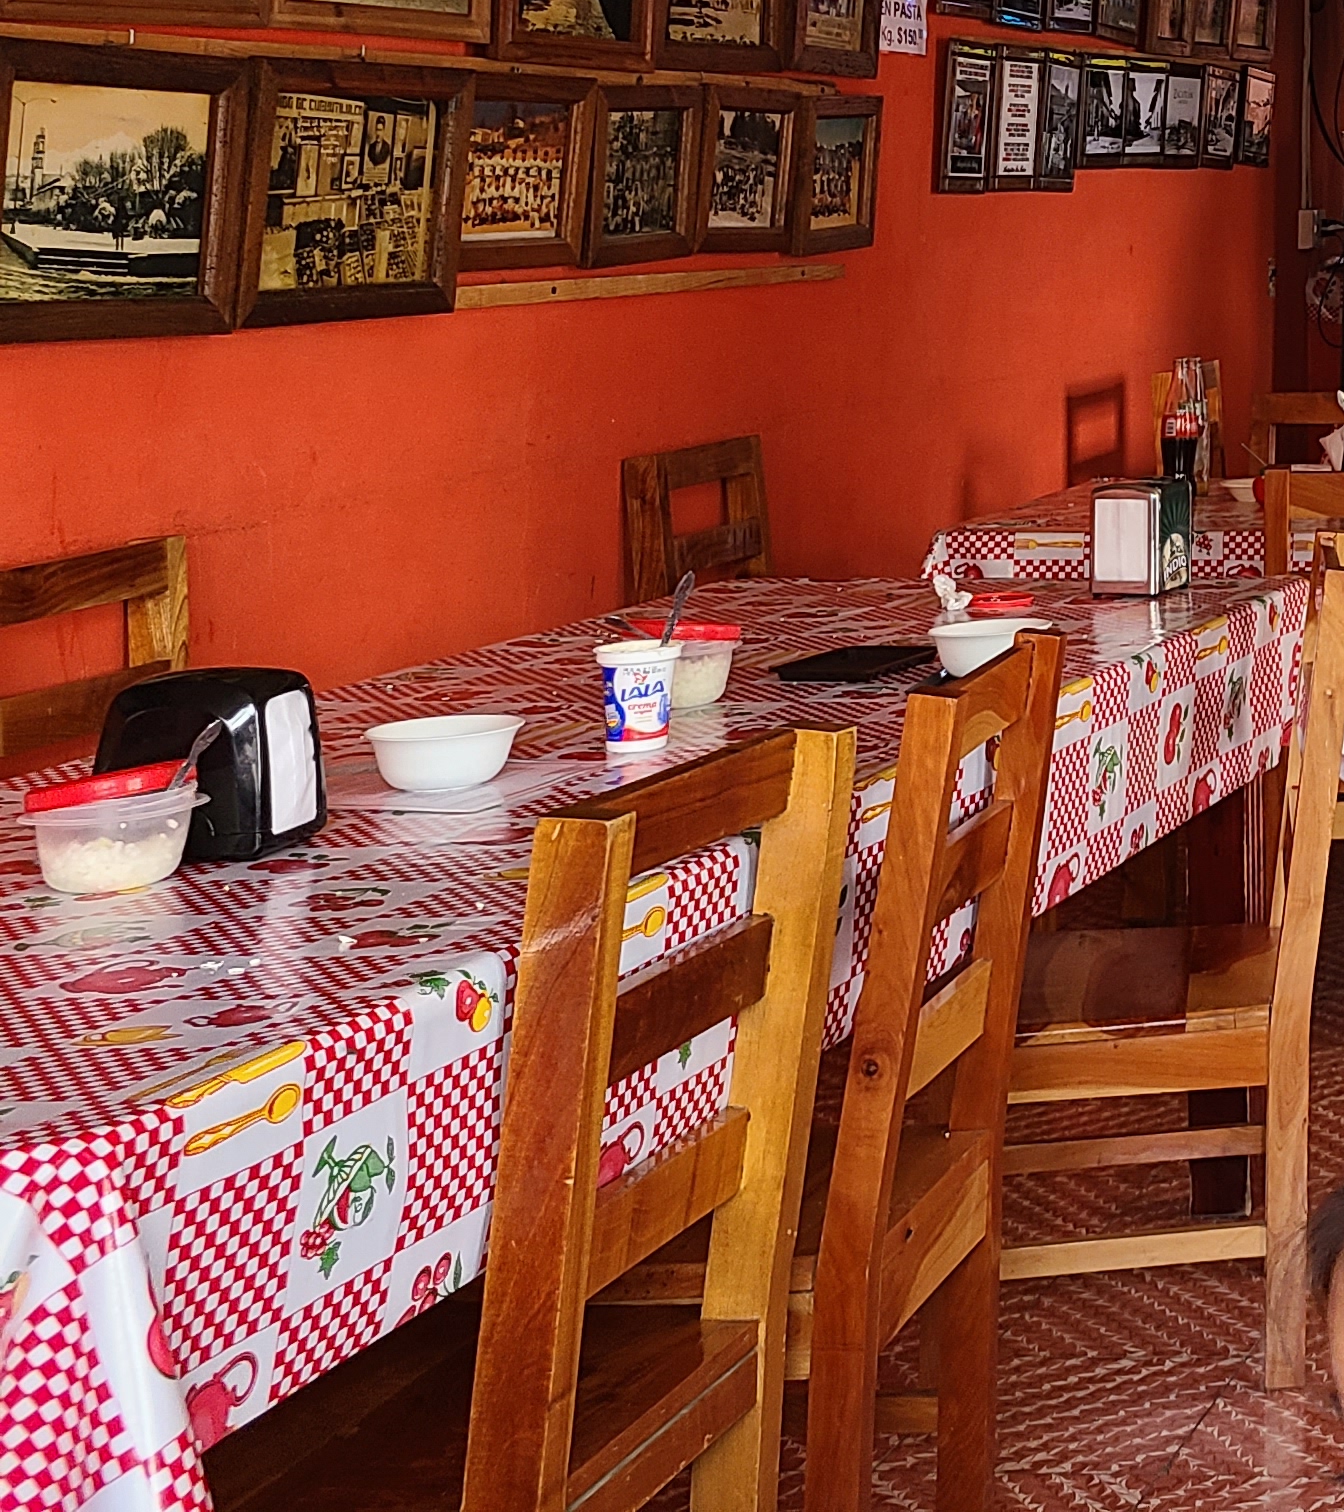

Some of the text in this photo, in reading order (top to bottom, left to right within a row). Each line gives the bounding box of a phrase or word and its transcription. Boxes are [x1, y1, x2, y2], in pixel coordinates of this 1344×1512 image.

[880, 0, 922, 21] EN PASTA
[1163, 555, 1187, 582] INDIO
[621, 680, 665, 702] LALA
[627, 702, 657, 710] crema
